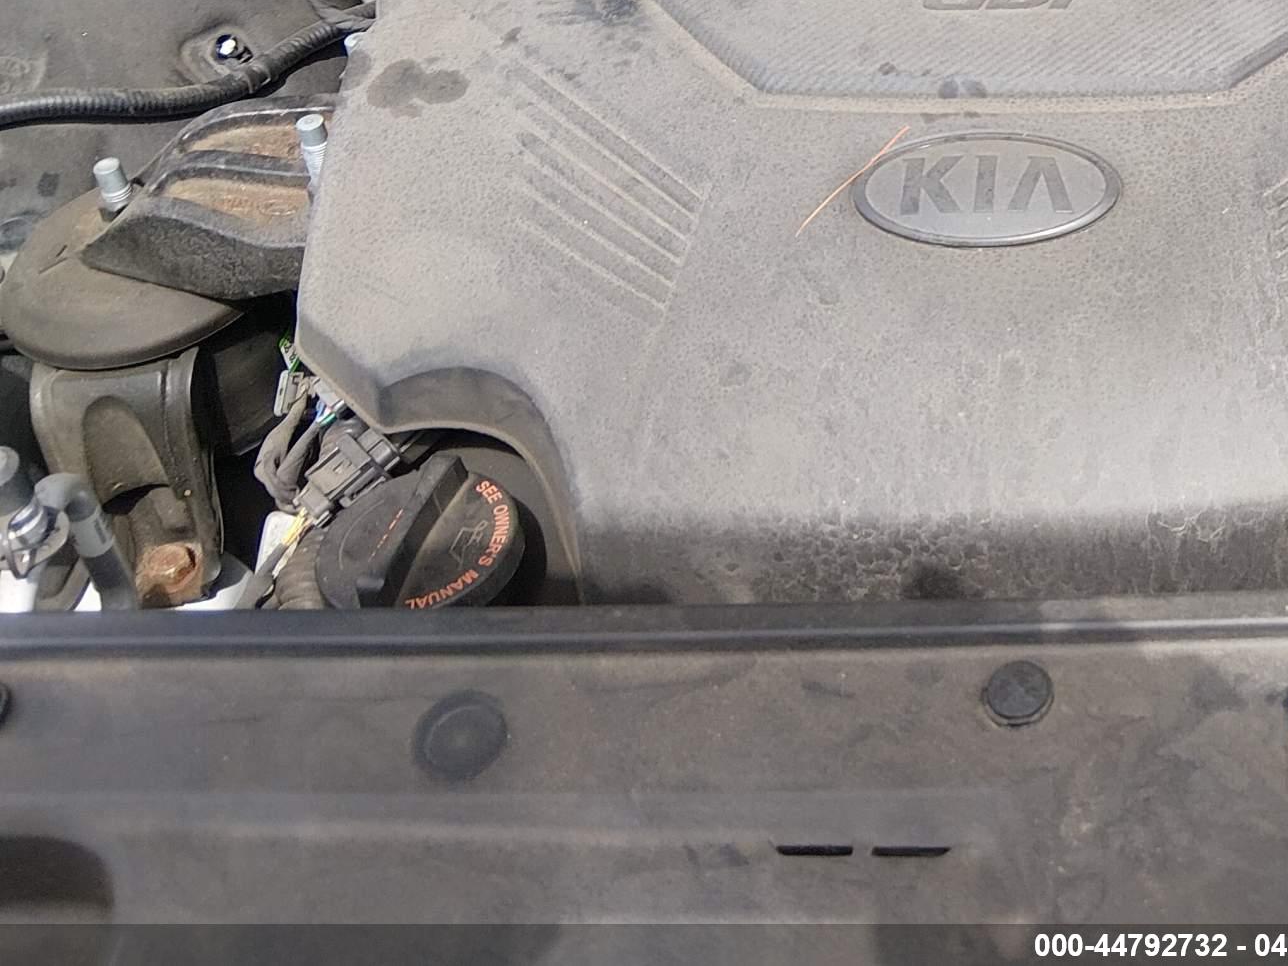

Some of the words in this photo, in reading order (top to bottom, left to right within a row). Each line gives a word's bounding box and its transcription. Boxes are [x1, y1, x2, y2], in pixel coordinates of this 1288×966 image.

[900, 155, 1075, 215] KIA
[476, 480, 503, 504] SEE
[478, 504, 510, 567] OWNER'S
[404, 569, 479, 610] MANUAL
